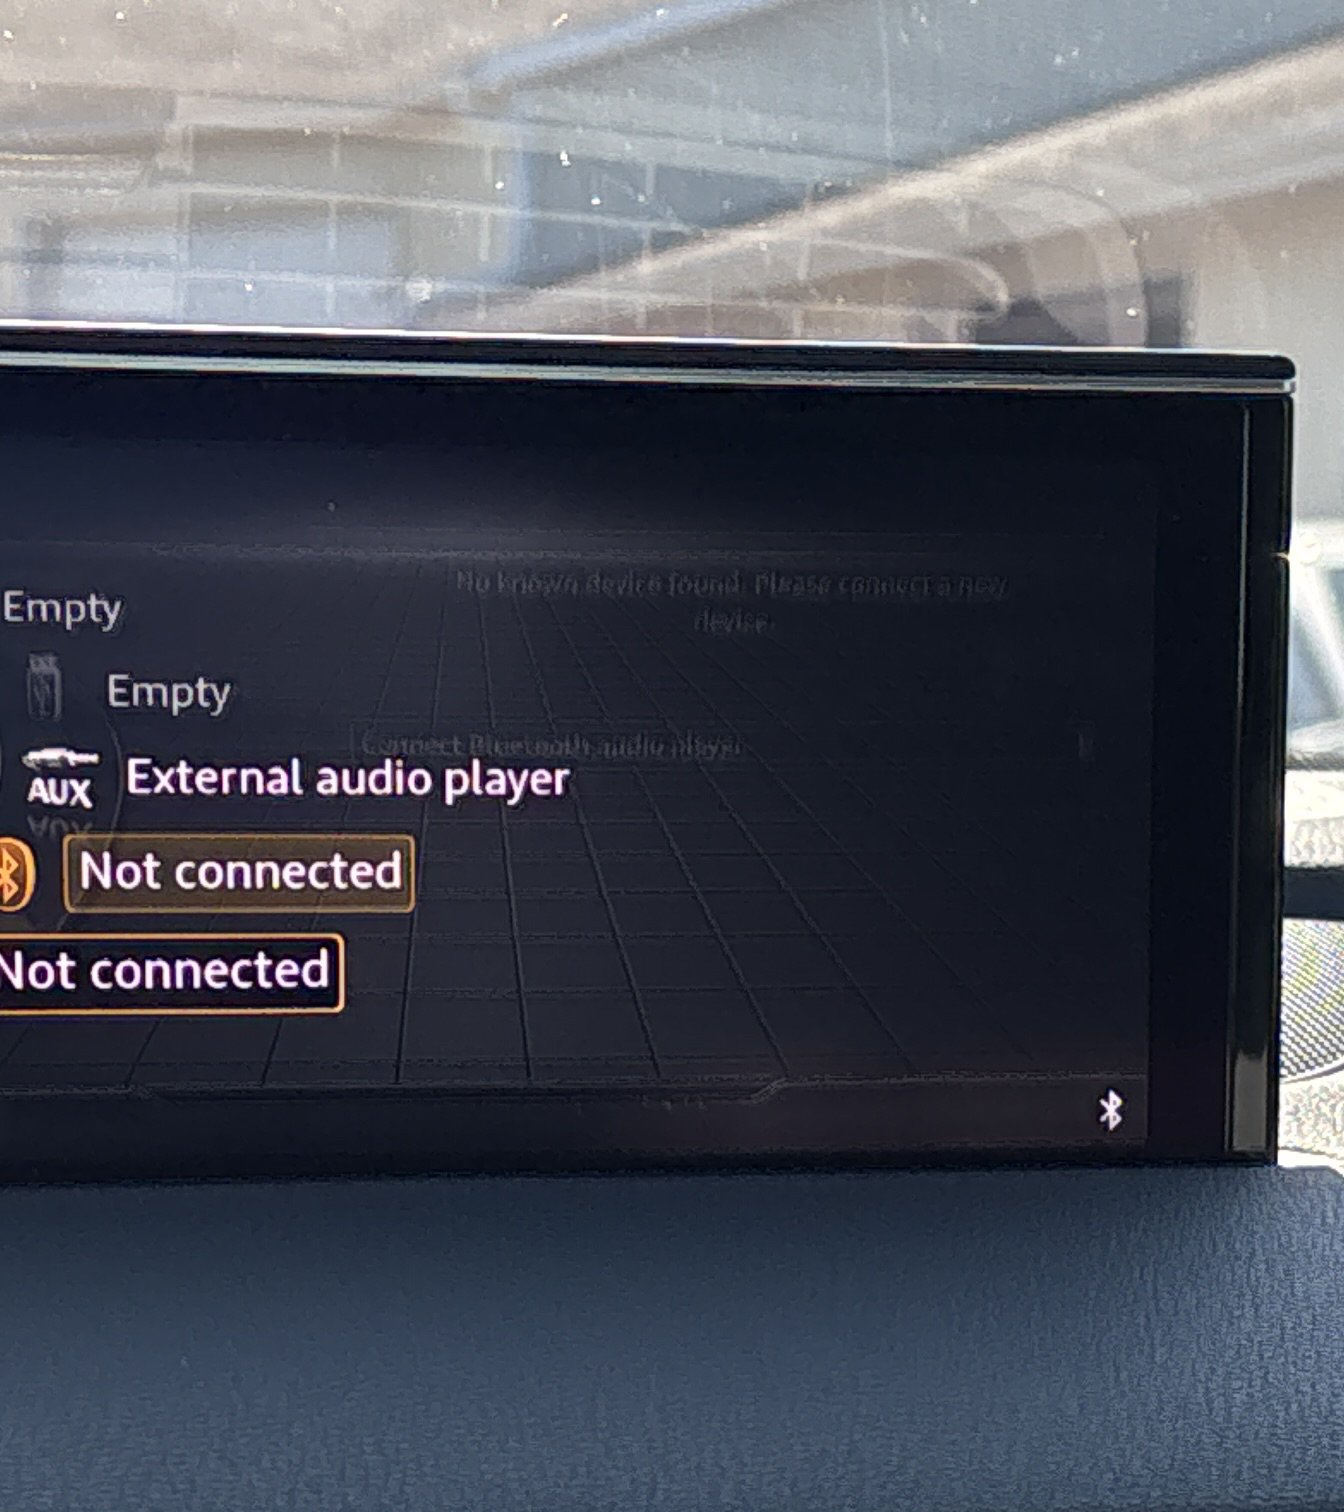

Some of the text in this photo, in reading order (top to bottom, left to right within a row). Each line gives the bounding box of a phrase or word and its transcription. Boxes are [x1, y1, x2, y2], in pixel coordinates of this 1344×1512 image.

[496, 569, 578, 595] known
[586, 568, 663, 595] device
[3, 589, 122, 632] Empty
[107, 673, 231, 716] Empty
[26, 776, 93, 809] AUX
[126, 756, 571, 806] External audio player
[80, 850, 403, 891] Not connected
[89, 947, 330, 990] connected
